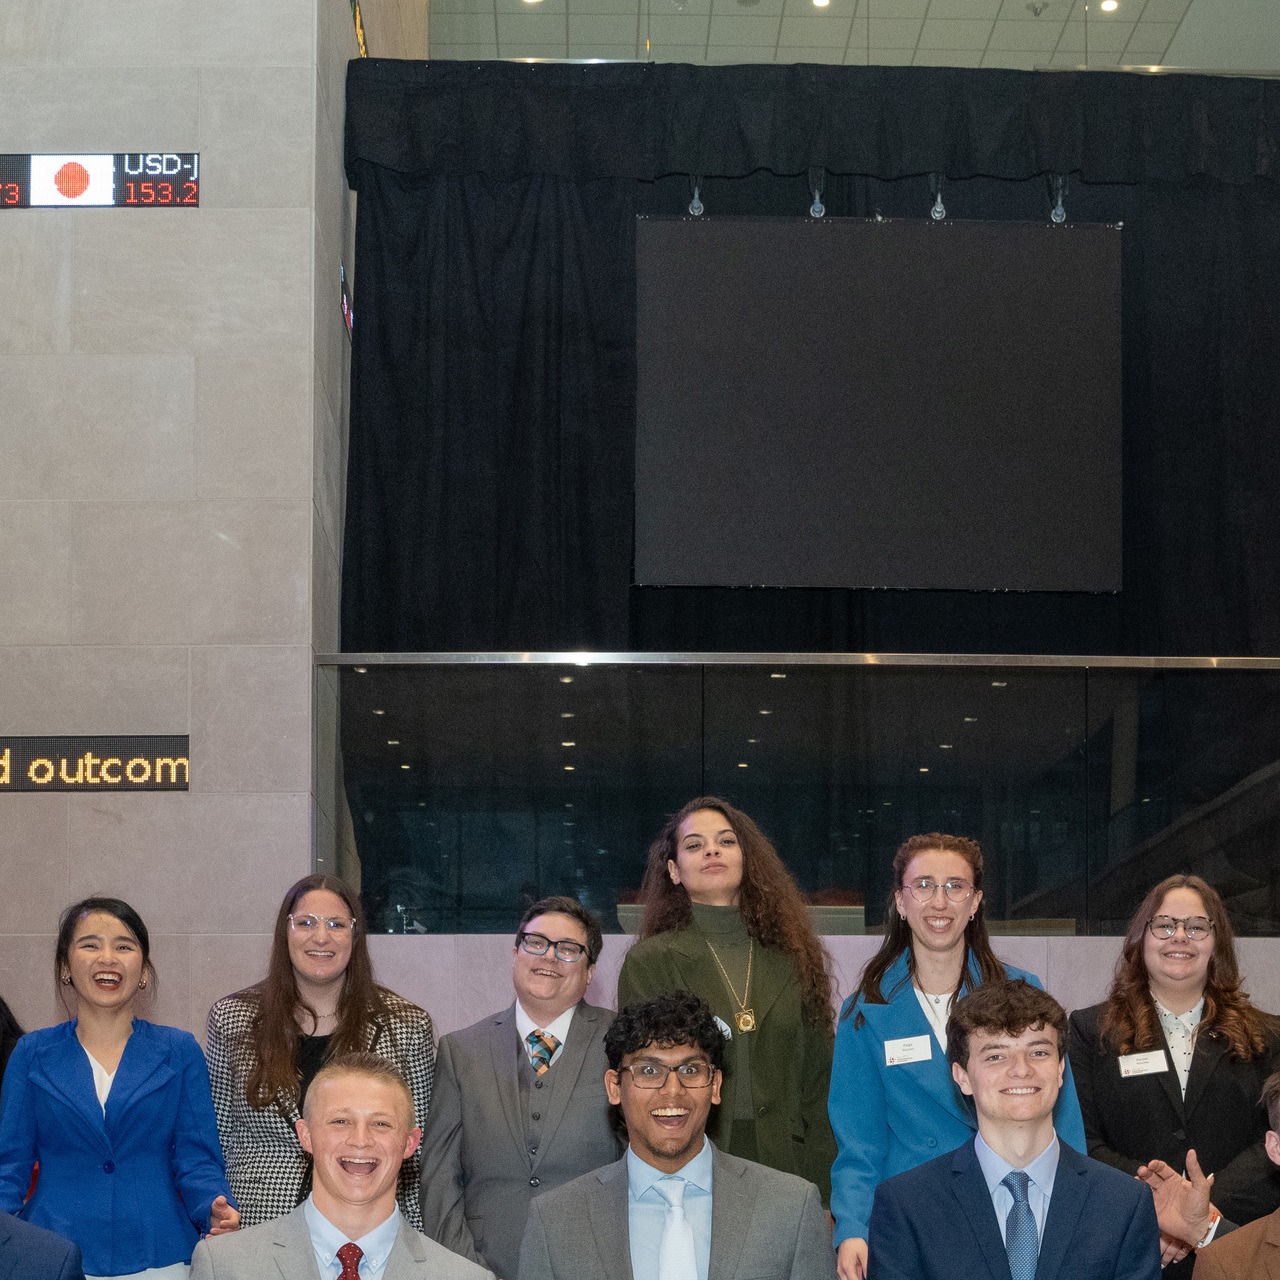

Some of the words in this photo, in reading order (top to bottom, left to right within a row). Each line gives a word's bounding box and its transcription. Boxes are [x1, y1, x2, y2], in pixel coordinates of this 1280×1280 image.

[124, 153, 198, 181] USD-J
[126, 181, 199, 204] 153.2
[27, 751, 190, 784] outcom
